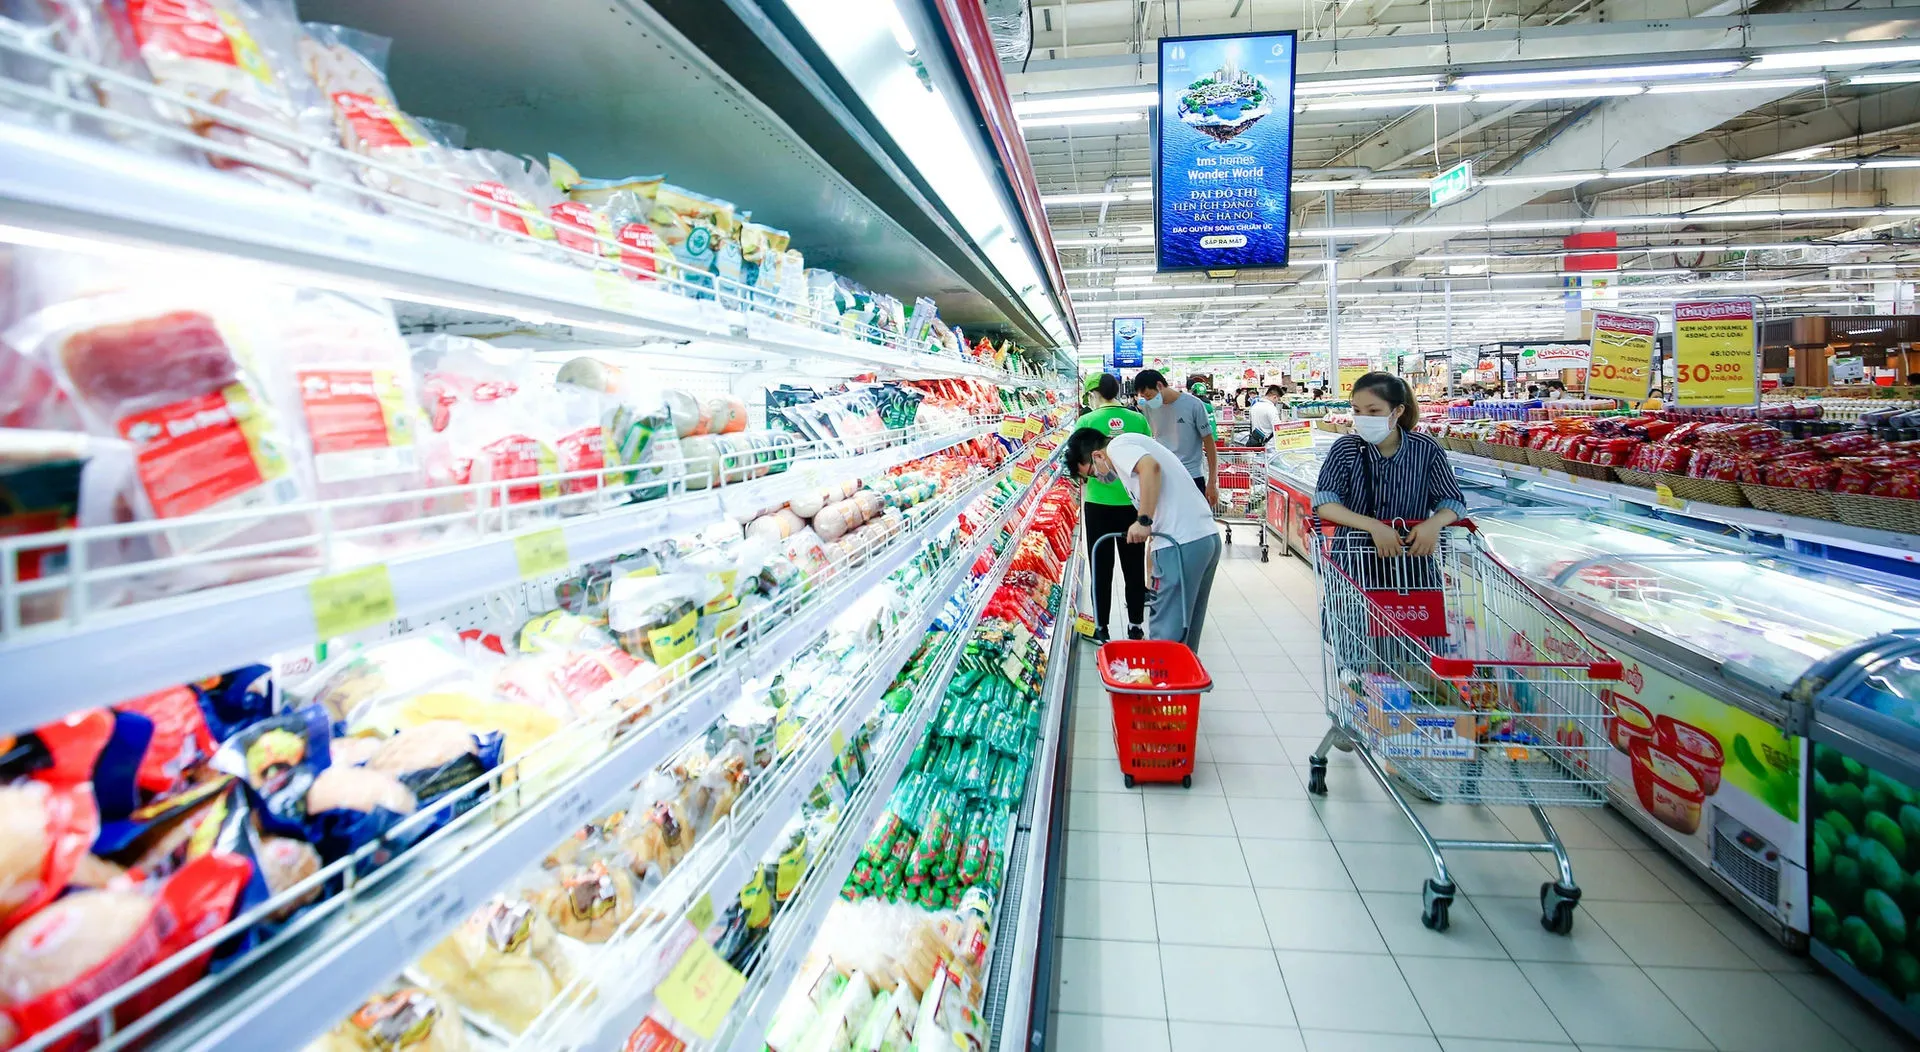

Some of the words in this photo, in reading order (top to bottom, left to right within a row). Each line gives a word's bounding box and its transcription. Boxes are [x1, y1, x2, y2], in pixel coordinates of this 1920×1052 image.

[1197, 157, 1217, 166] tms
[1220, 155, 1255, 166] homes
[1188, 169, 1229, 179] Wonder
[1232, 167, 1263, 178] World
